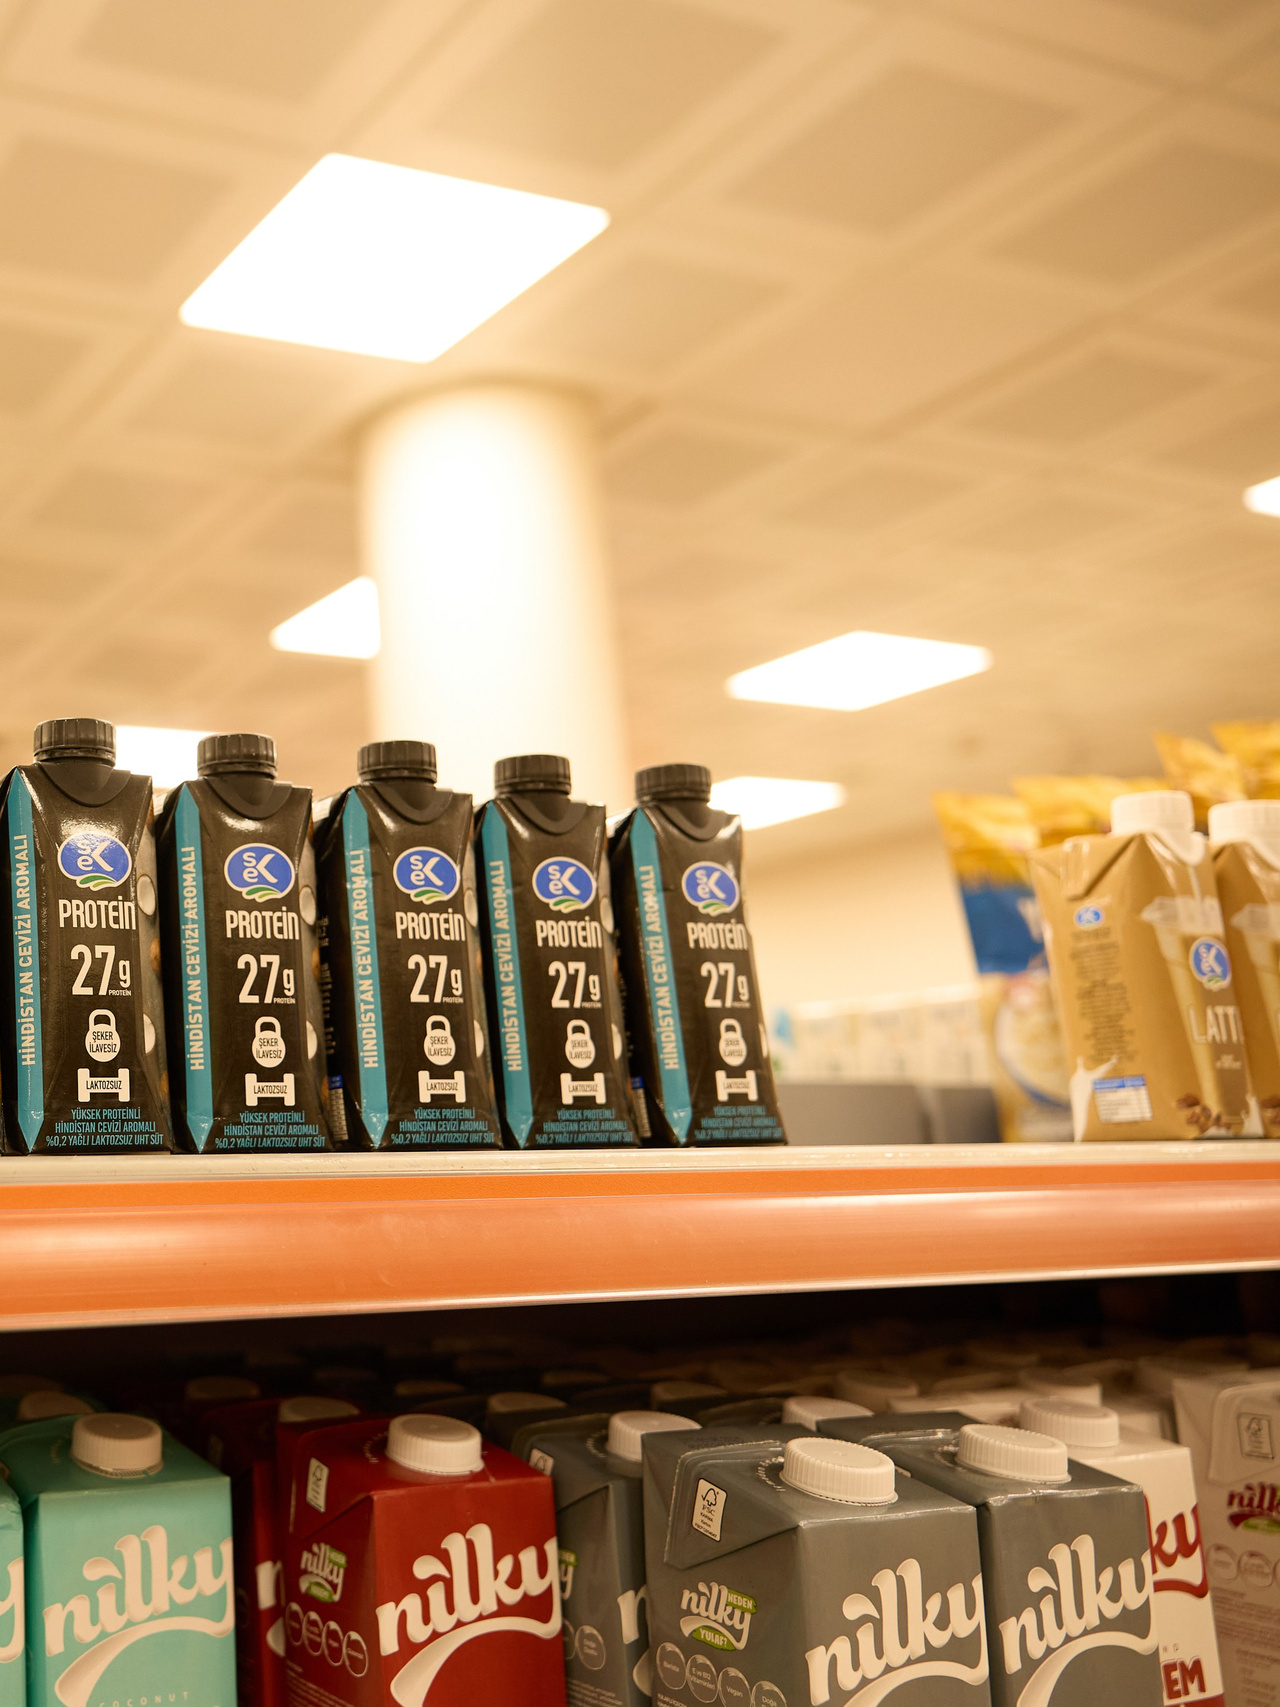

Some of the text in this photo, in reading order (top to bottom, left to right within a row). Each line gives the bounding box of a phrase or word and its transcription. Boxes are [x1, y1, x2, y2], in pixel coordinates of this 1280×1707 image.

[14, 834, 31, 910] AROMALI
[181, 846, 199, 919] AROMALI
[86, 1080, 122, 1089] LAKTOZSUZ
[253, 1085, 287, 1094] LAKTOZSUZ
[43, 1525, 234, 1658] nilky
[375, 1523, 562, 1656] nilky
[681, 1582, 752, 1650] nilky
[728, 1592, 753, 1610] NEDEN
[999, 1534, 1159, 1675] nilky
[700, 1628, 728, 1648] YULAF?
[805, 1558, 989, 1706] nilky
